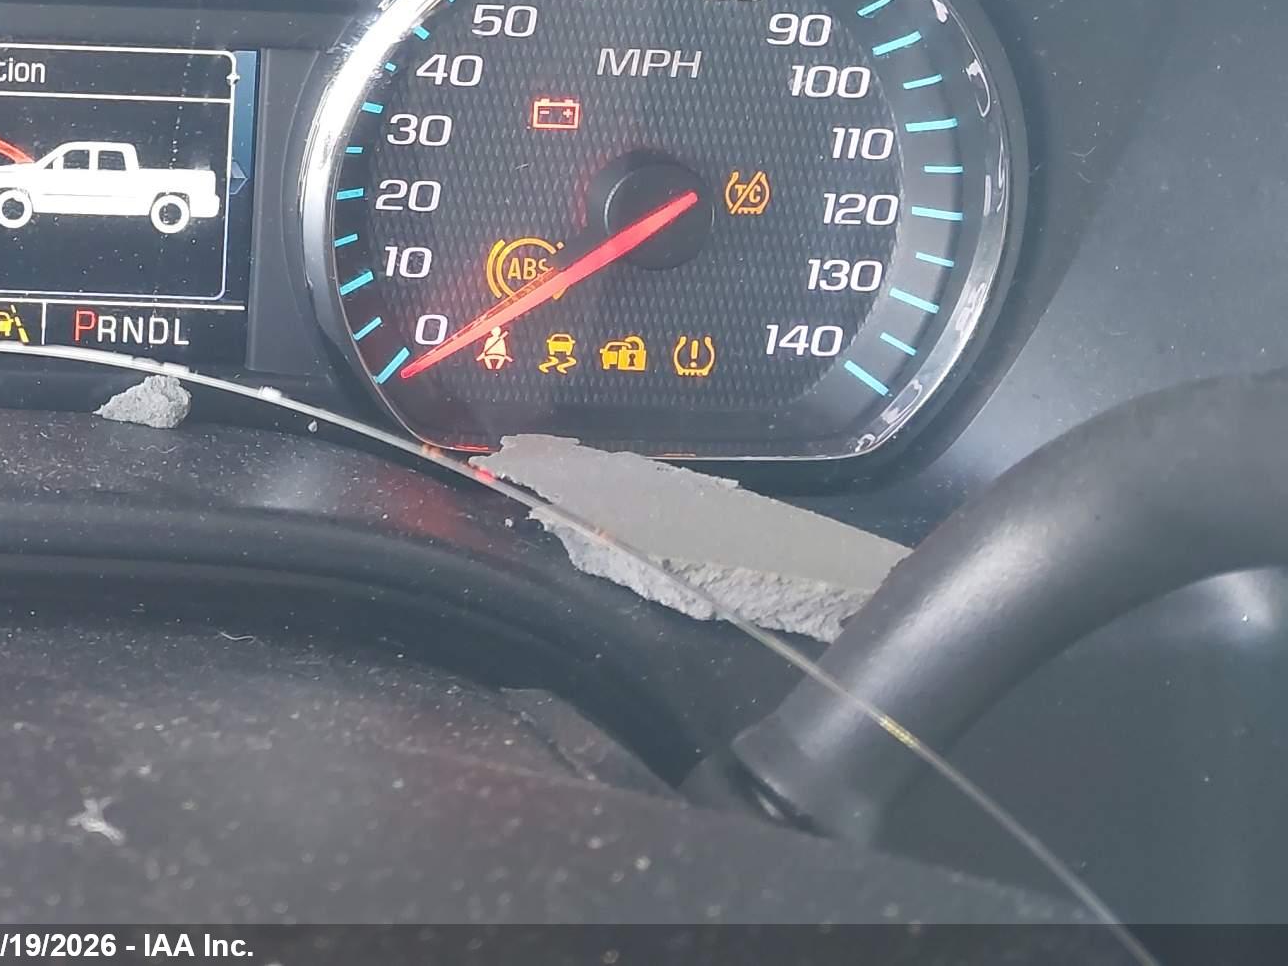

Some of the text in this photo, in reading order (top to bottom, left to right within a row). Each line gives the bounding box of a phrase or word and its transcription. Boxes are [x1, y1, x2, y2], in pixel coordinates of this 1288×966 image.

[471, 6, 539, 37] 50
[767, 14, 832, 46] 90
[416, 55, 484, 87] 40
[596, 48, 702, 79] MPH
[789, 65, 871, 98] 100
[386, 116, 453, 147] 30
[831, 128, 894, 160] 110
[375, 181, 442, 213] 20
[822, 193, 899, 226] 120
[384, 247, 432, 278] 10
[808, 259, 883, 291] 130
[74, 309, 190, 346] PRNDL
[414, 314, 448, 345] 0
[764, 325, 843, 357] 140
